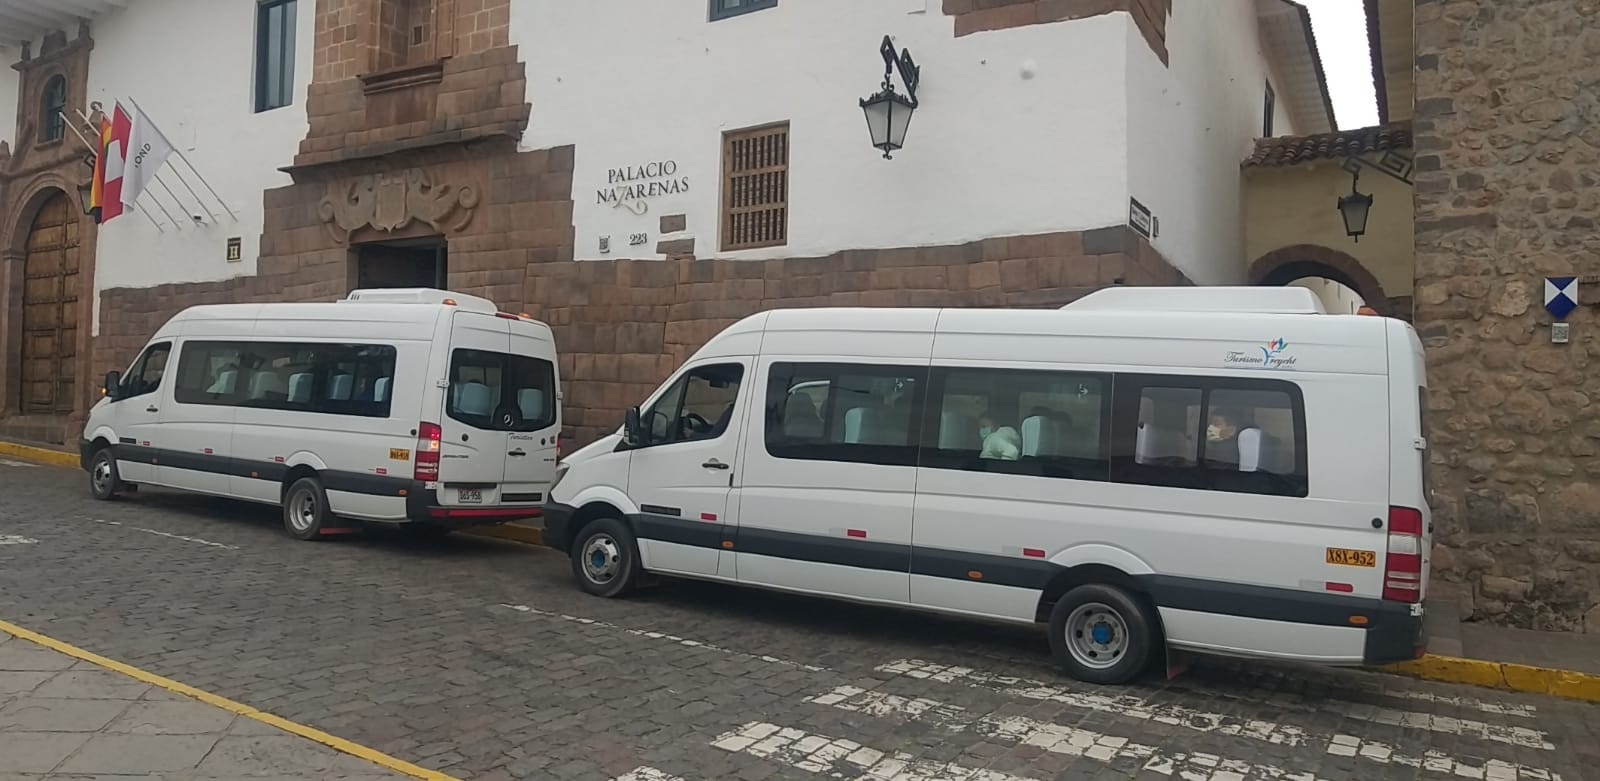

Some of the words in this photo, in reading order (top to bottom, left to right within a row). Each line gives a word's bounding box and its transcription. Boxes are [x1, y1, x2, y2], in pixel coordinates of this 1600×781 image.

[608, 160, 677, 184] PALACIO
[596, 176, 689, 215] NAZARENAS
[629, 232, 648, 246] 223
[1224, 351, 1263, 363] Turismo
[1328, 549, 1374, 565] X8X-952
